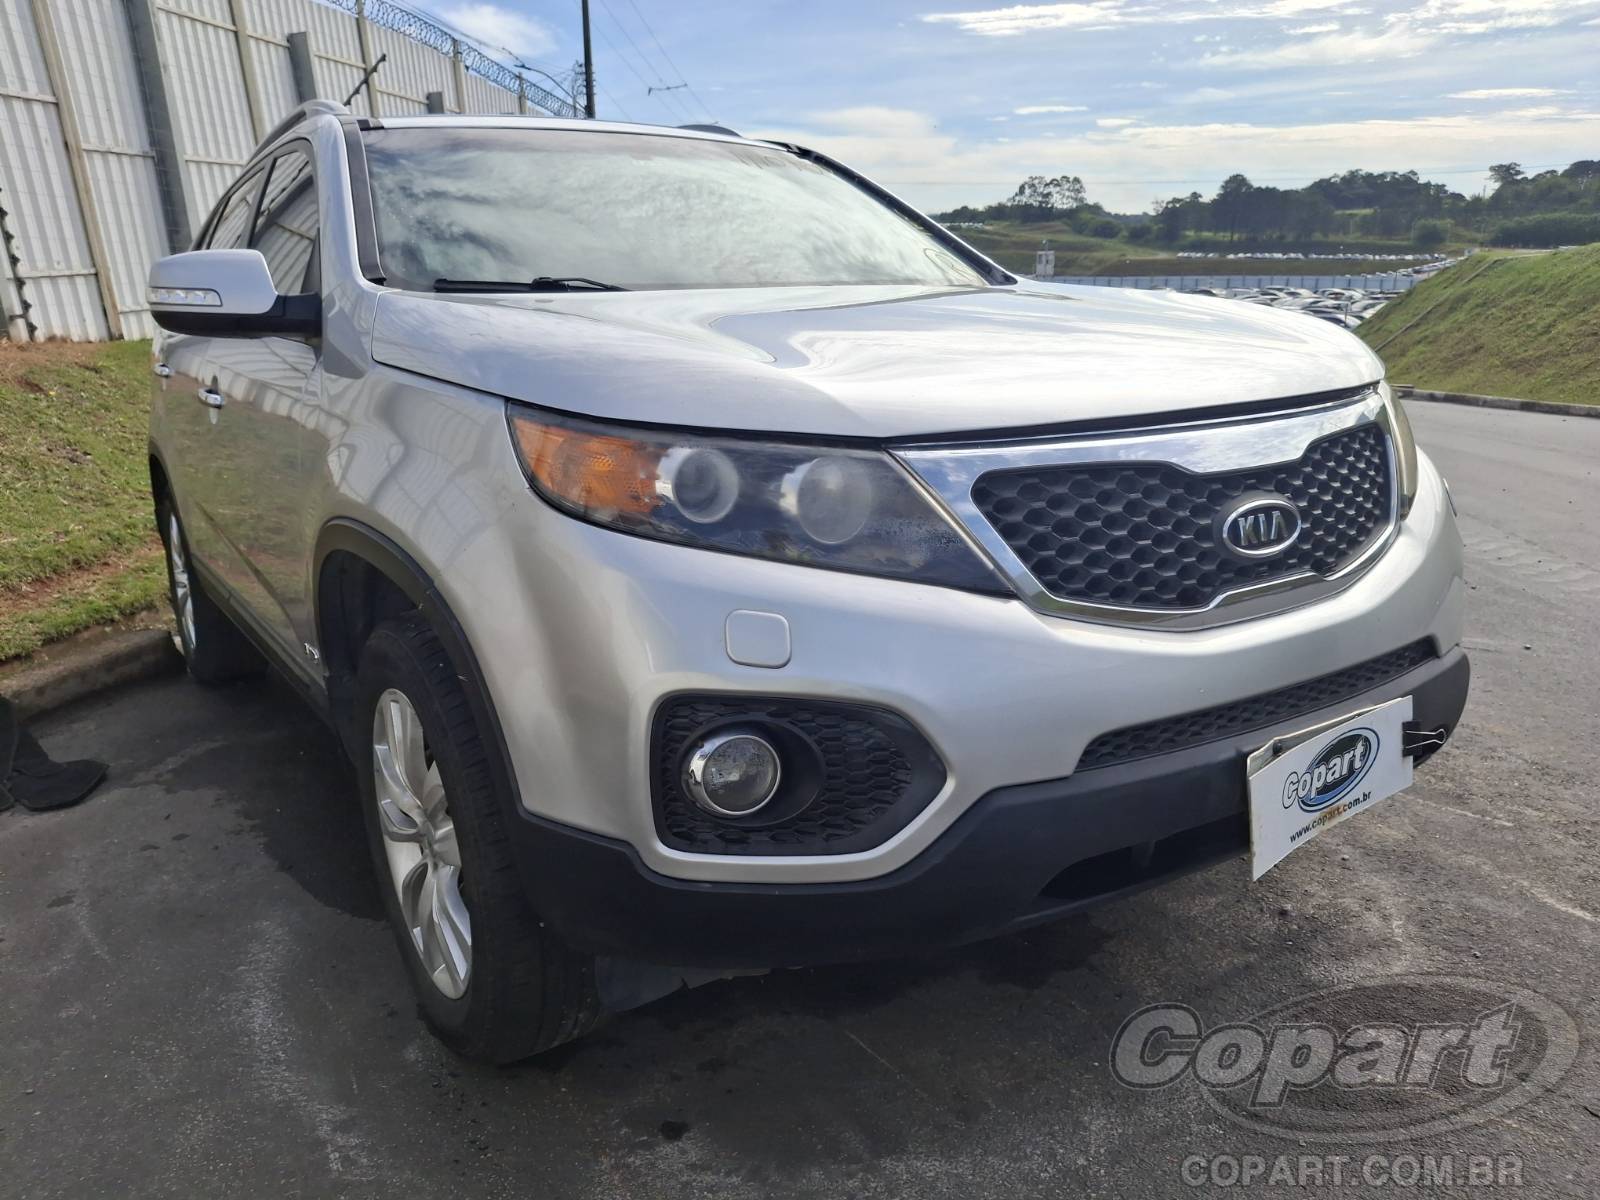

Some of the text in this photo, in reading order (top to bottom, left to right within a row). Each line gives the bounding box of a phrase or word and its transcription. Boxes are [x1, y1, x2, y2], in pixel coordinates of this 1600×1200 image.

[1238, 511, 1288, 546] KIA
[1282, 736, 1366, 809] Copart
[1290, 791, 1371, 843] www.copart.com.br
